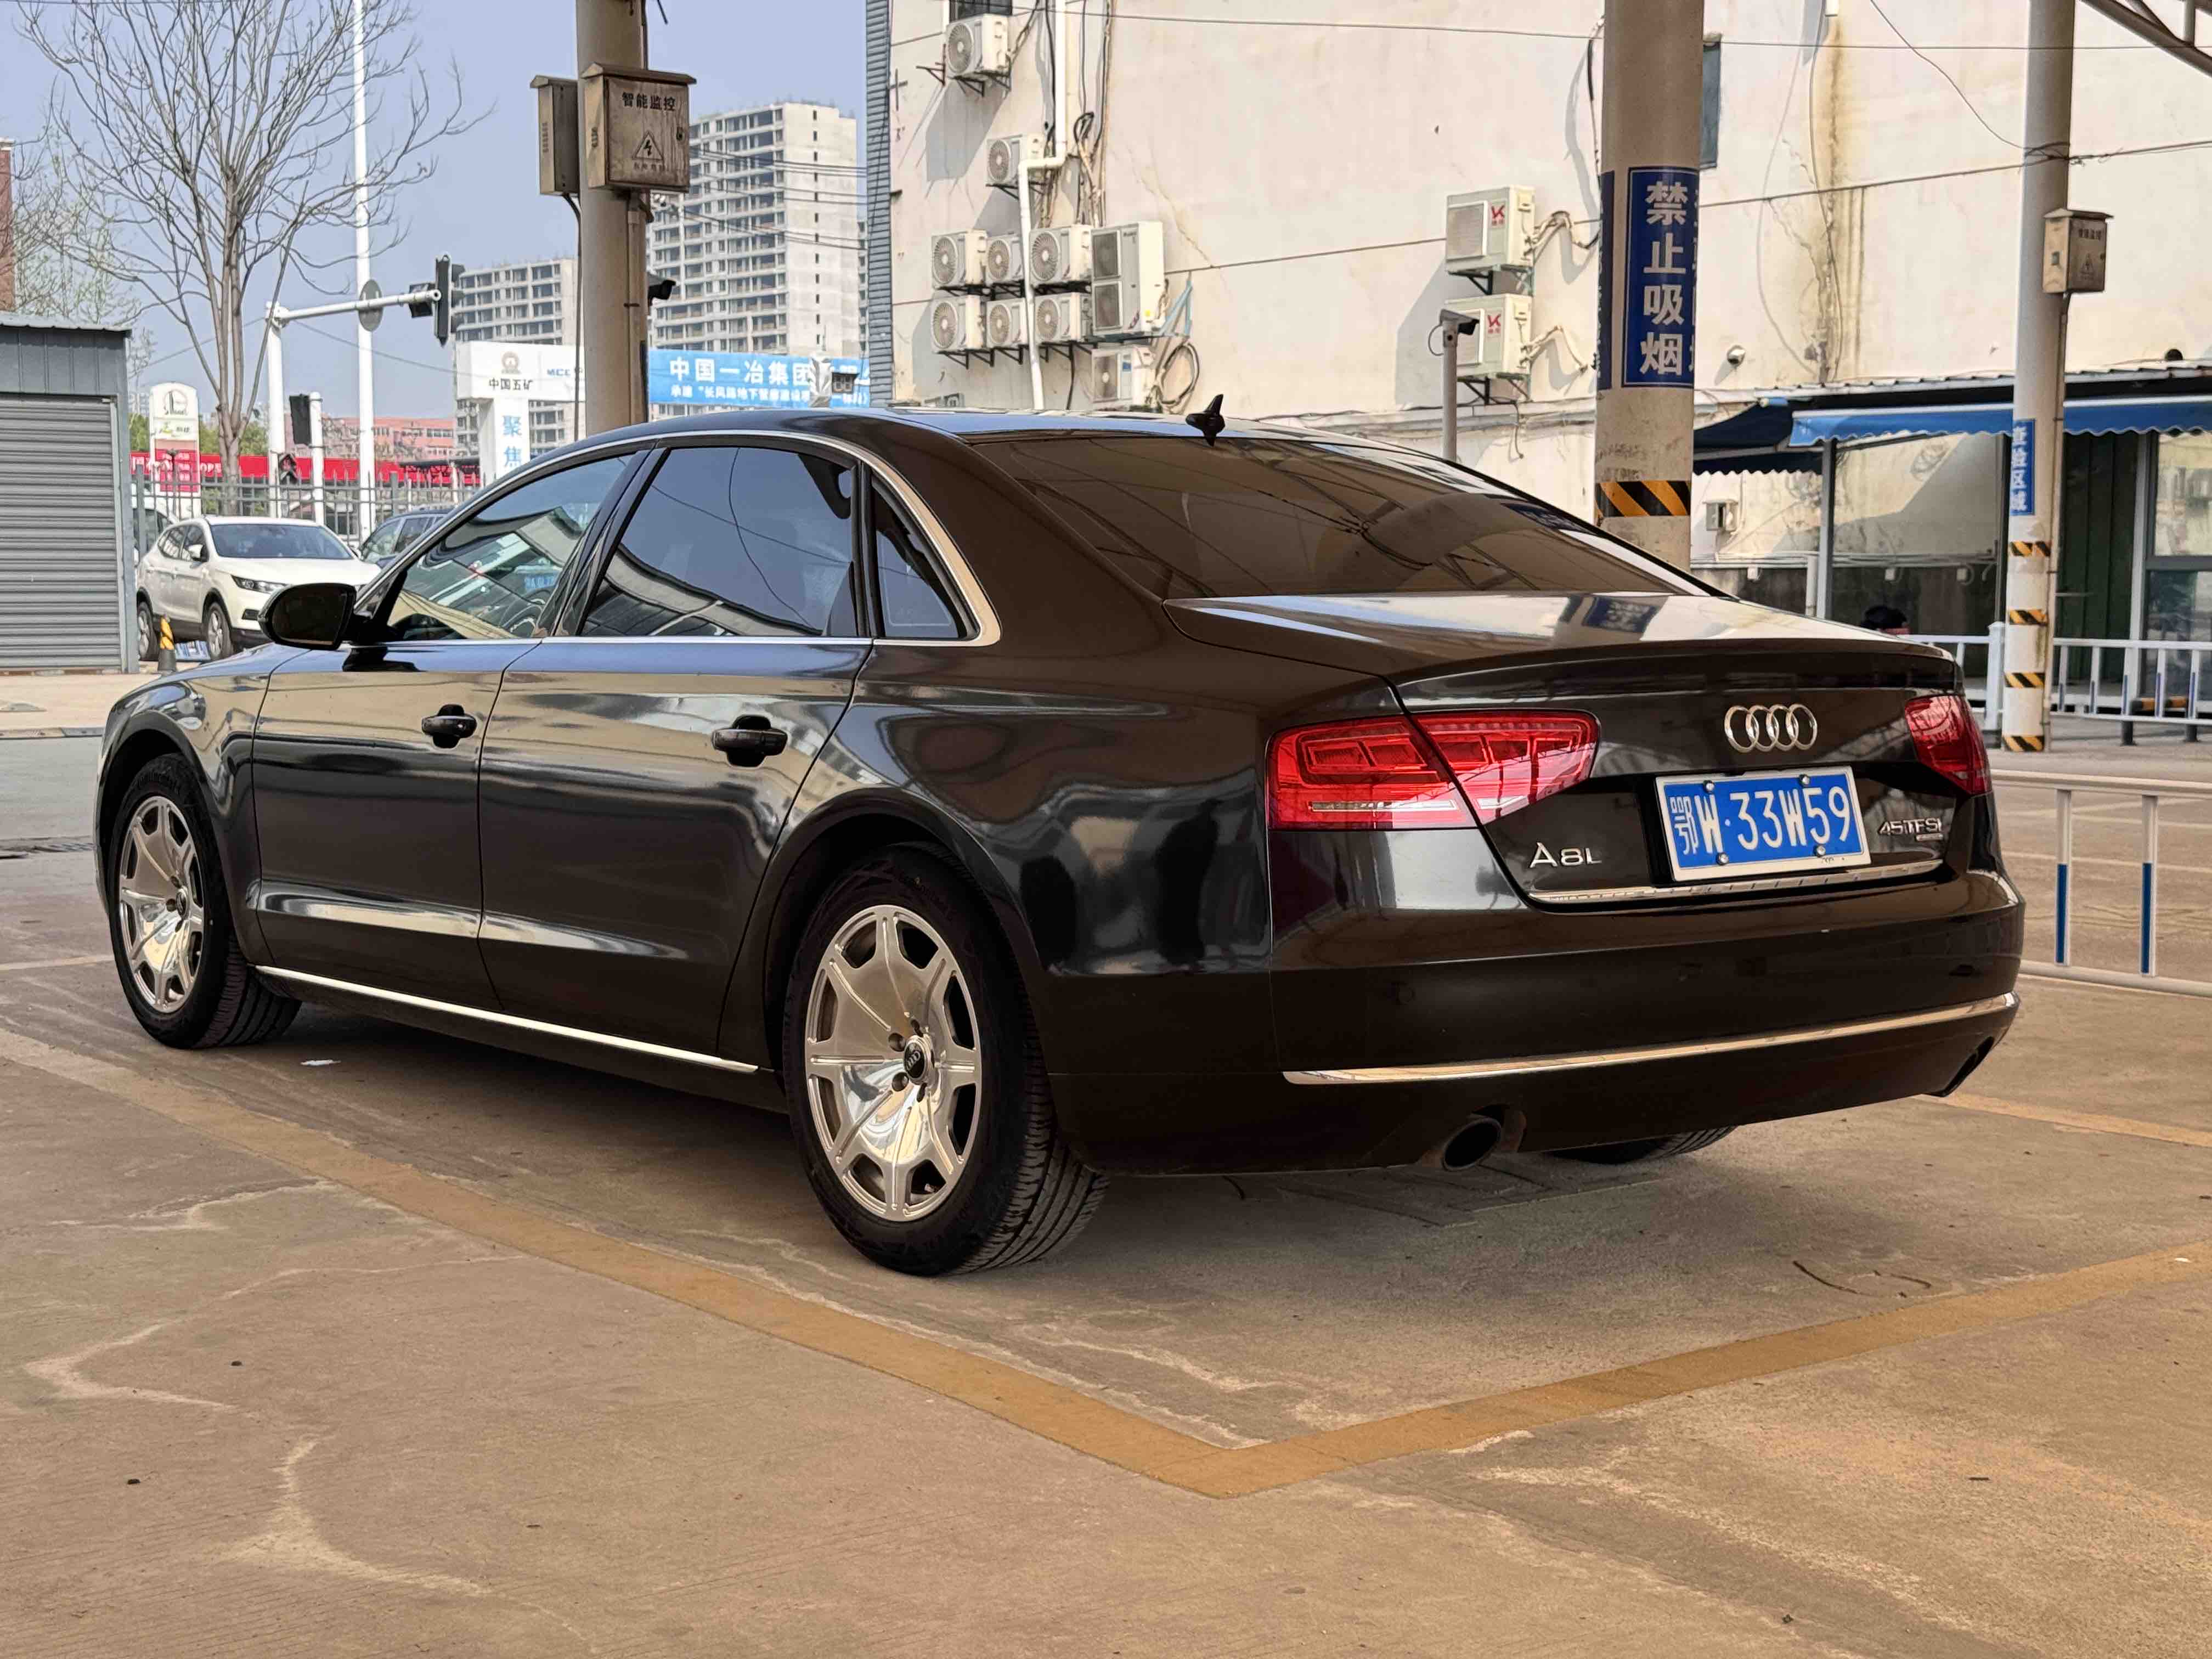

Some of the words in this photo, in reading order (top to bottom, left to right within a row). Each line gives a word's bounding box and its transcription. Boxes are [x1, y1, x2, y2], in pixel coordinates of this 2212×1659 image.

[622, 92, 675, 111] 智能监控
[1639, 180, 1688, 376] 禁止吸烟
[489, 377, 533, 390] 中国五矿
